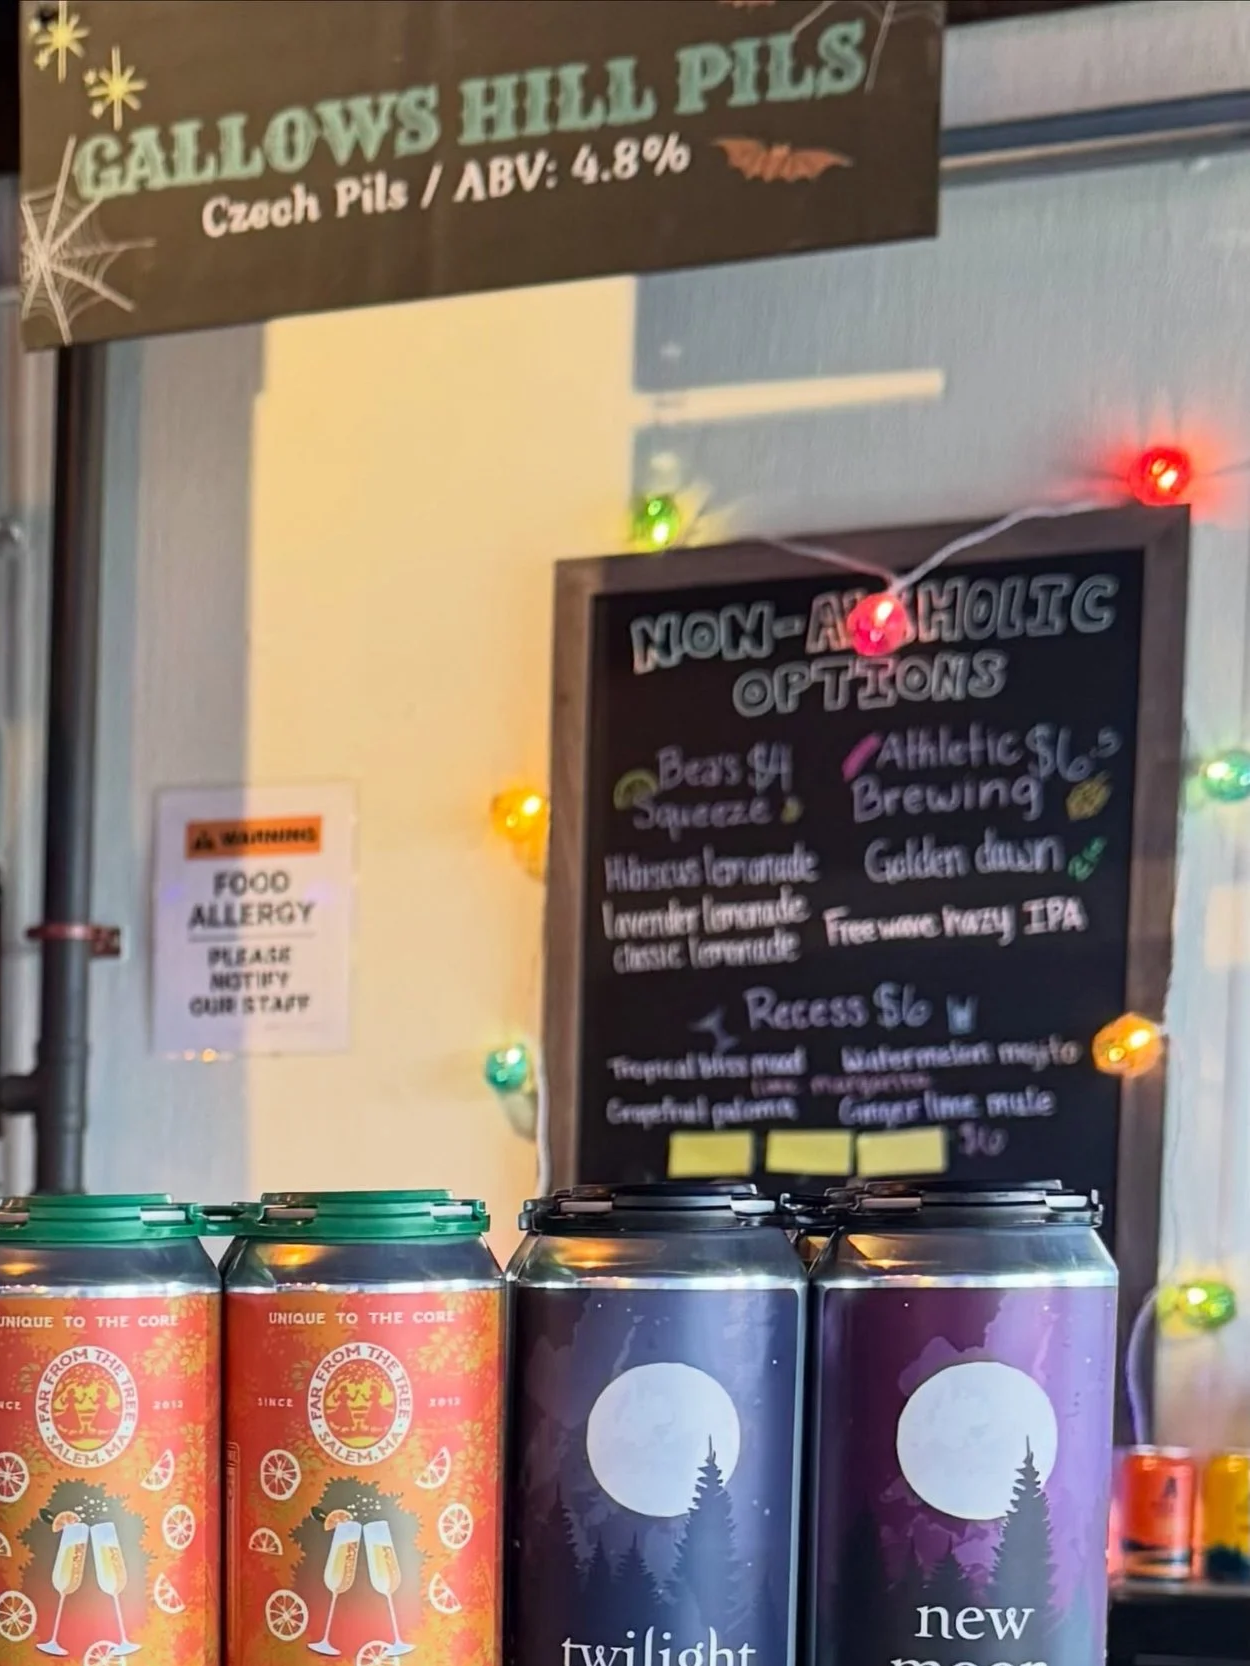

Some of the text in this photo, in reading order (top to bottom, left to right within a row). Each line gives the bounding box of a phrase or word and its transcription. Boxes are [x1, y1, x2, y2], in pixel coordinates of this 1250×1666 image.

[72, 20, 866, 201] GALLOWS HILL PILS
[202, 183, 320, 238] Czech
[335, 169, 409, 218] Pils
[453, 149, 558, 203] ABV:
[571, 131, 691, 186] 4.8%
[733, 650, 1007, 717] OPTIONS
[876, 722, 1023, 770] Athletic
[633, 796, 772, 842] Squeeze
[852, 774, 1044, 823] Brewing
[864, 834, 970, 884] Golden
[214, 870, 290, 896] FOOD
[188, 901, 315, 931] ALLERGY
[1023, 896, 1089, 935] IPA
[208, 946, 291, 966] PLEASE
[209, 971, 290, 992] NOTIFY
[243, 995, 311, 1015] STAFF
[743, 981, 933, 1030] Recess $6
[914, 1604, 1035, 1640] new
